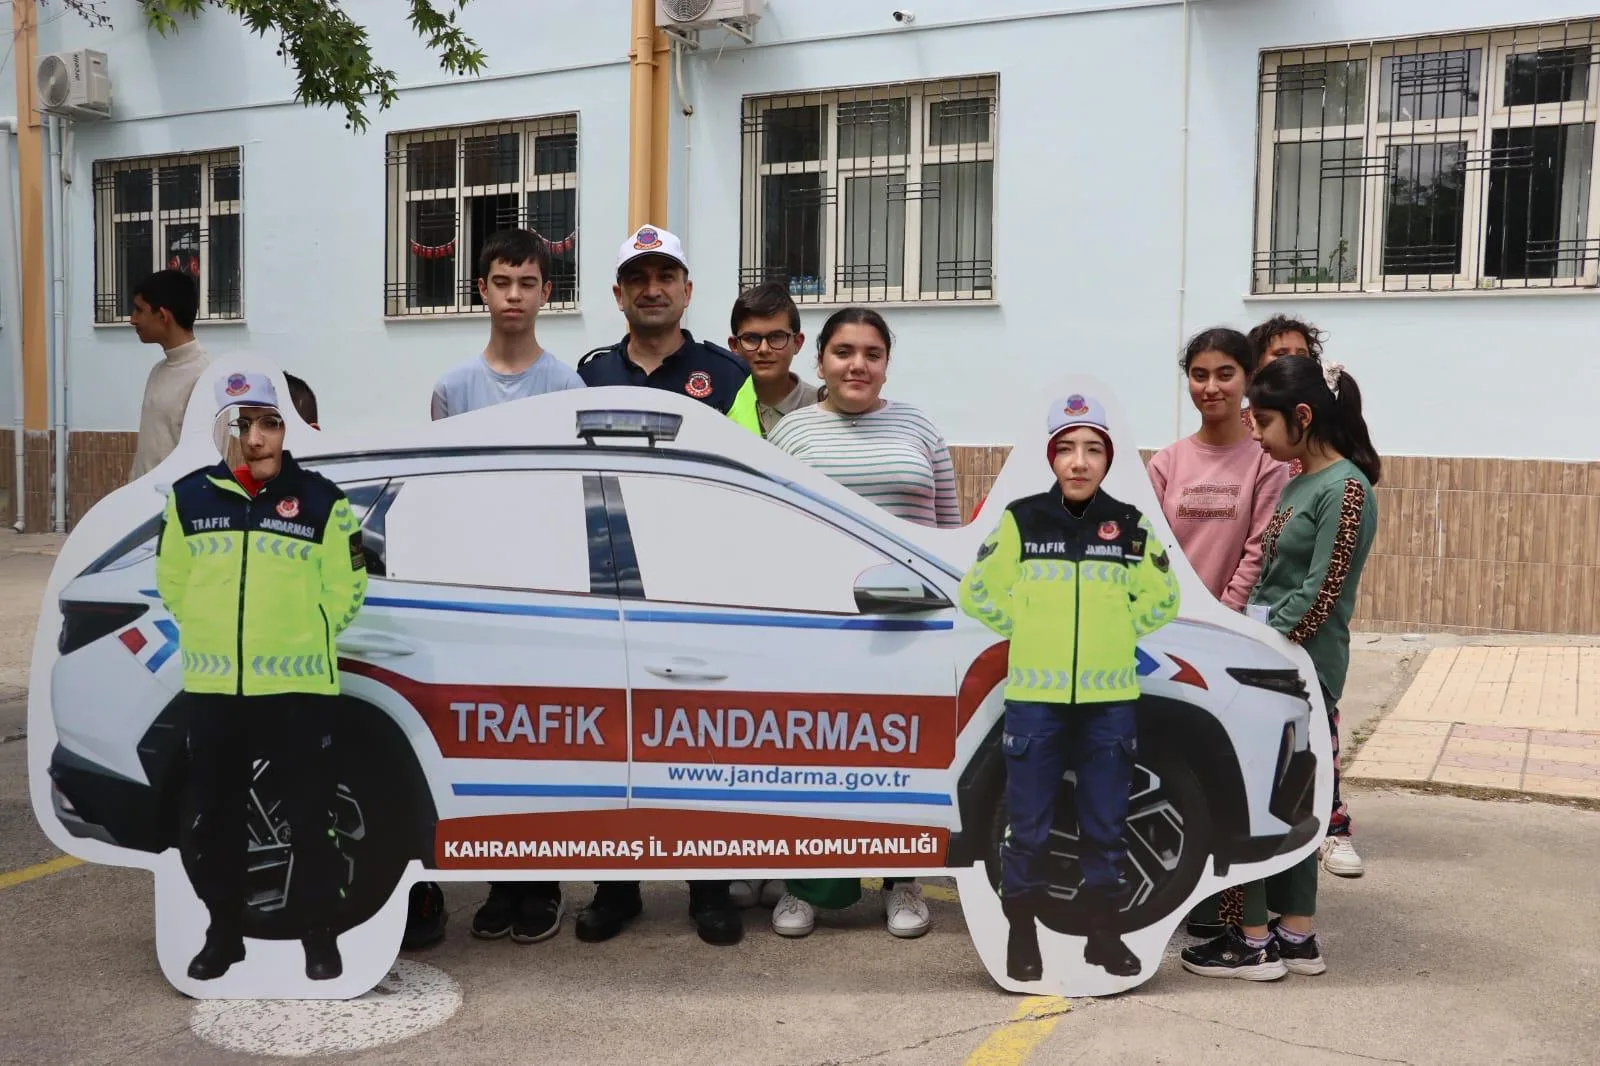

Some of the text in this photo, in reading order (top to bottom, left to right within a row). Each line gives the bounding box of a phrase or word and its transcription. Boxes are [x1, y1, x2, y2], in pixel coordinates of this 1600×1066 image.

[260, 517, 315, 538] JANDARMASI
[641, 707, 920, 753] JANDARMASI
[668, 765, 910, 790] www.jandarma.gov.tr
[444, 840, 643, 861] KAHRAMANMARAŞ
[672, 840, 790, 857] JANDARMA
[795, 832, 938, 855] KOMUTANLIĞI
